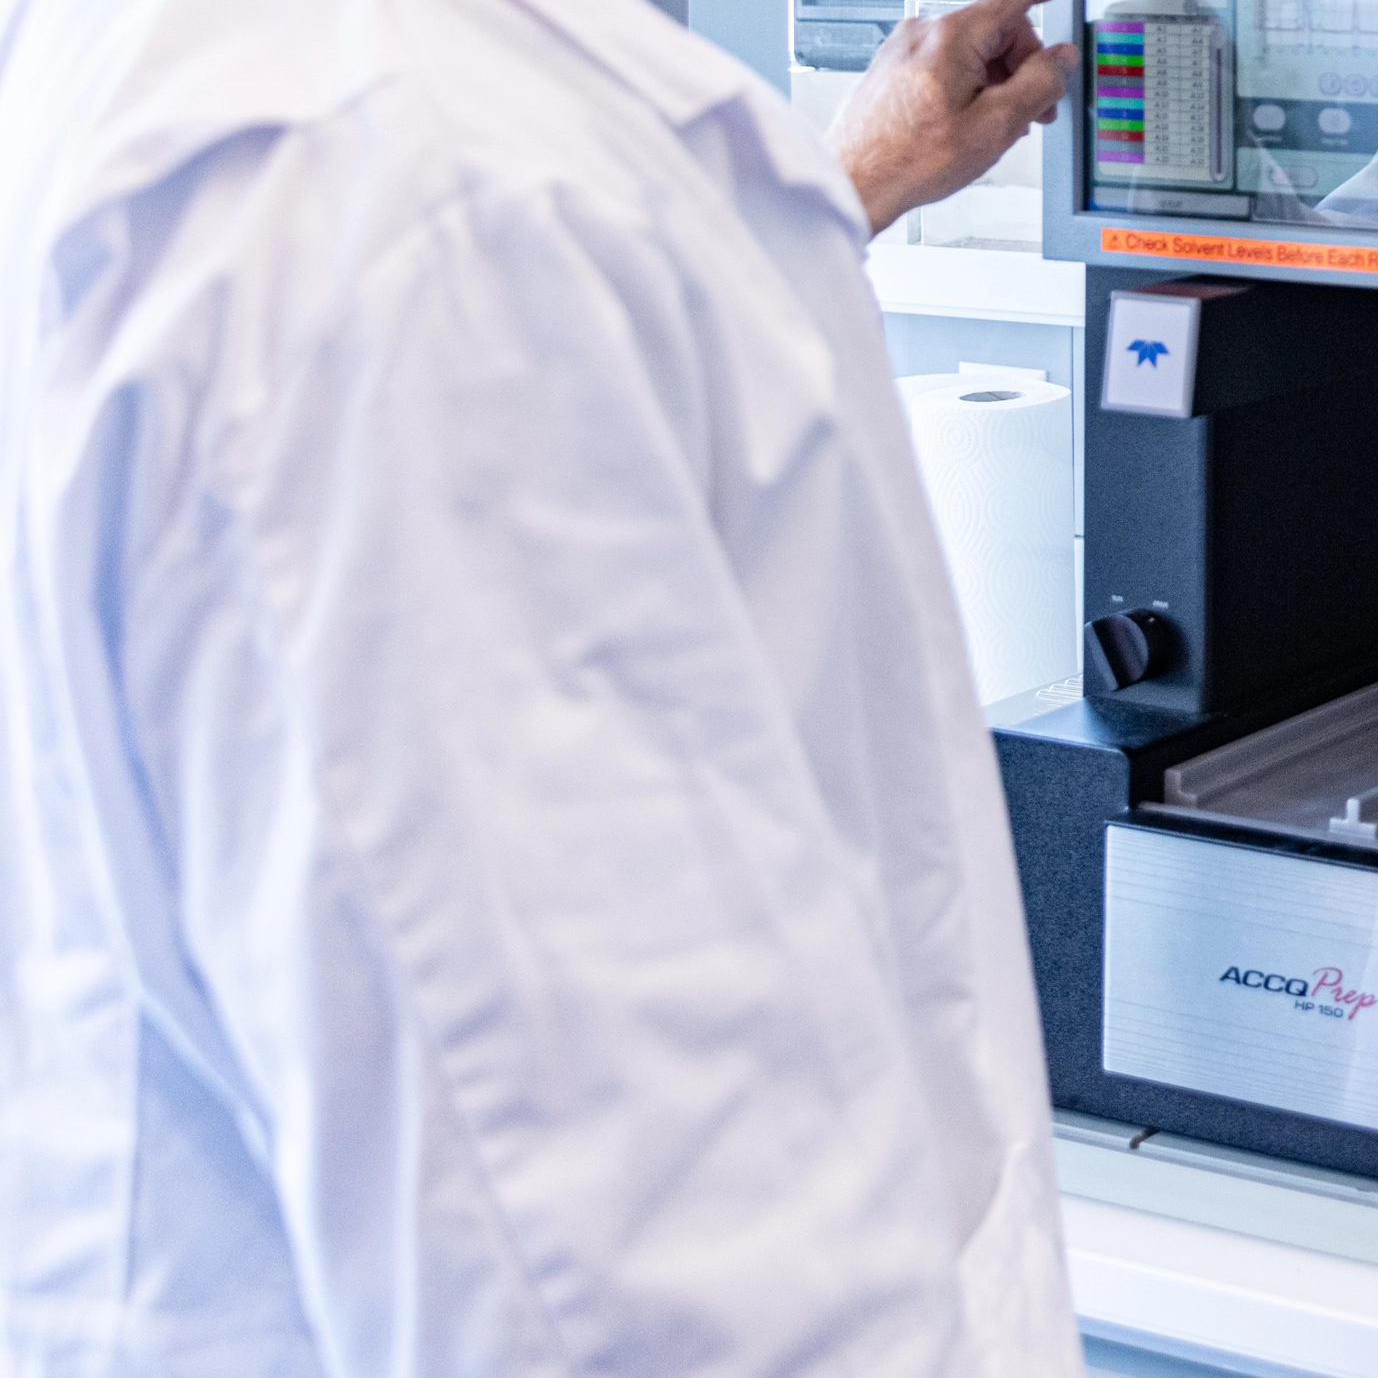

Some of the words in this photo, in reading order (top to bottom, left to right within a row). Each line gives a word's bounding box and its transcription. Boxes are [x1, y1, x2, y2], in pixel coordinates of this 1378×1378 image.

[1125, 233, 1168, 251] Check
[1173, 237, 1225, 257] Solvent
[1227, 241, 1273, 260] Levels
[1277, 246, 1324, 265] Before
[1327, 249, 1365, 268] Each
[1294, 1000, 1315, 1011] HP
[1318, 1004, 1344, 1018] 150
